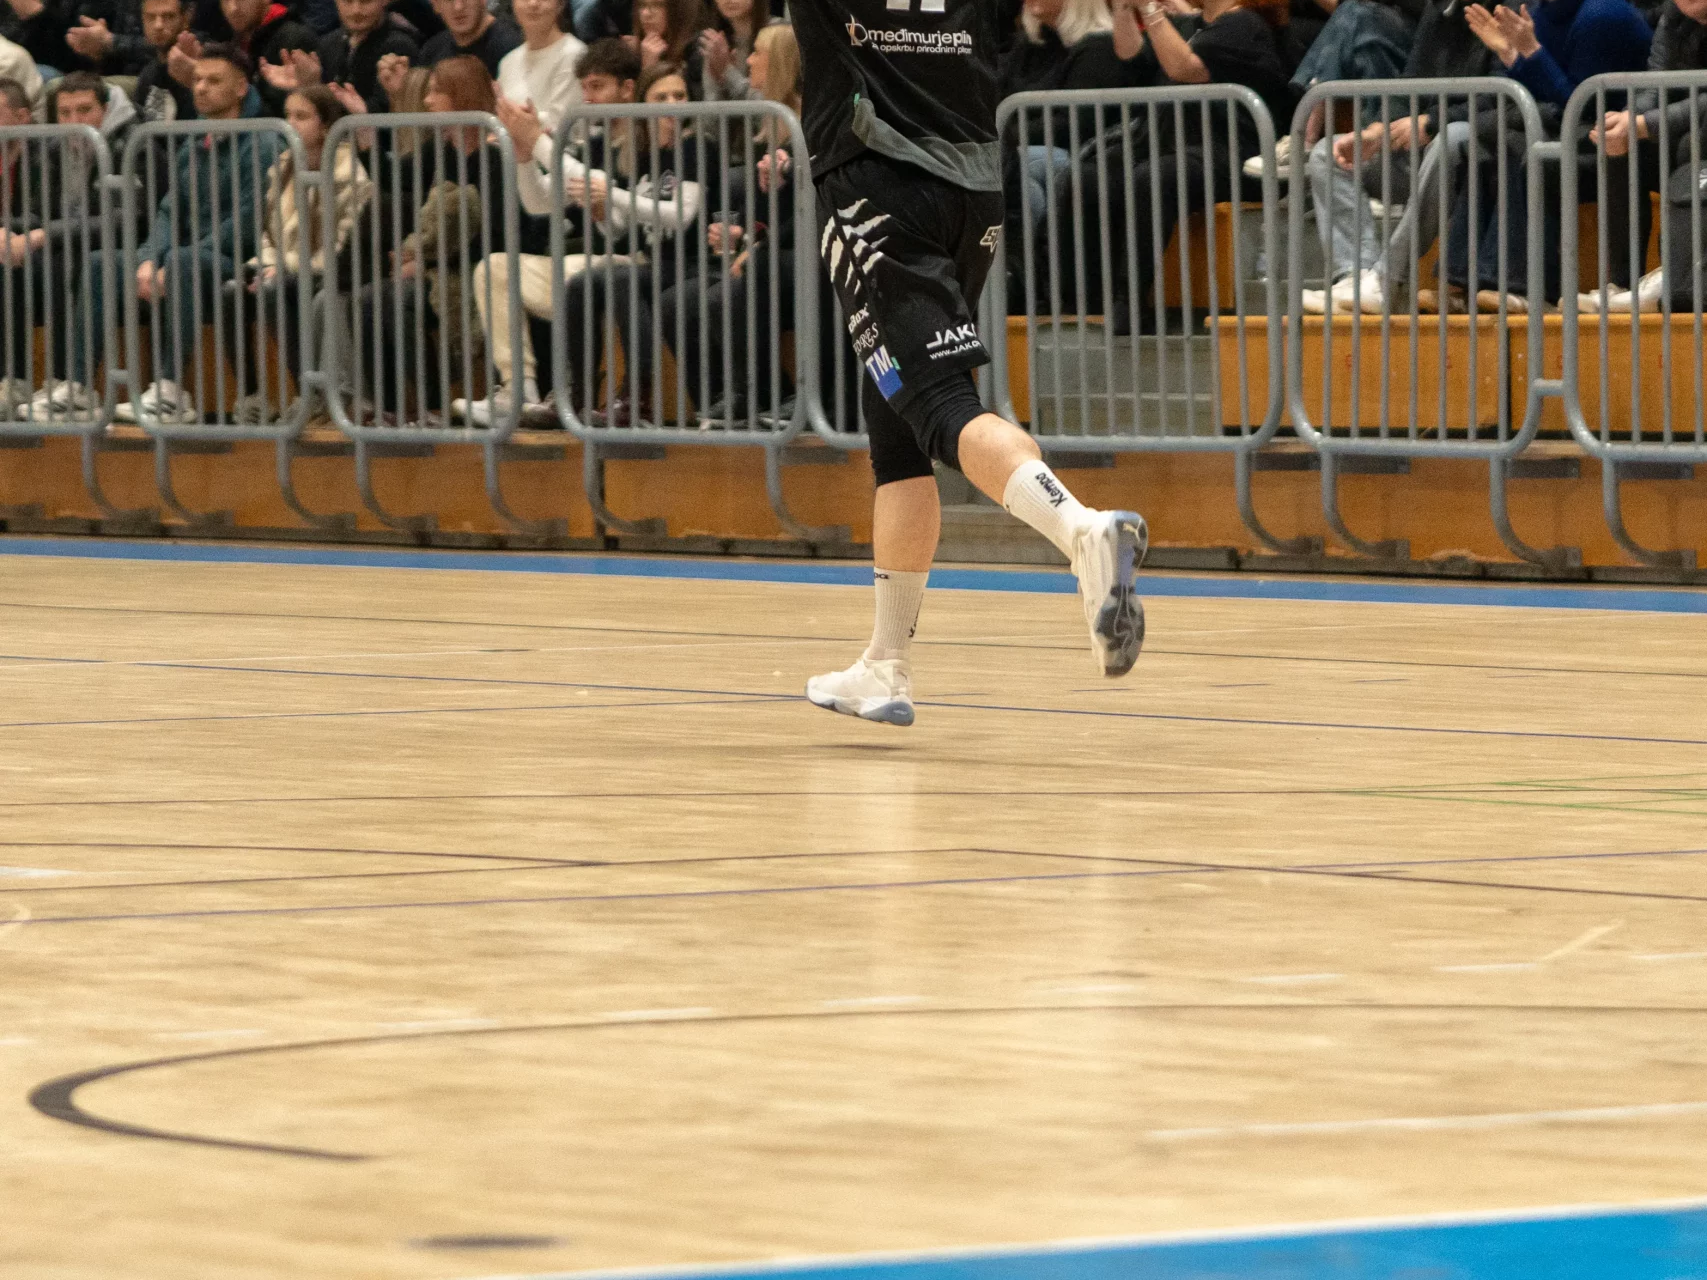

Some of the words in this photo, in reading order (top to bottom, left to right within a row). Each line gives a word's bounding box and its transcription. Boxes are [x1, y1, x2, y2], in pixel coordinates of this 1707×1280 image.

[880, 43, 915, 54] opskrbu
[916, 46, 956, 55] prirodnim
[865, 344, 895, 382] TM
[1035, 472, 1068, 508] Kempa
